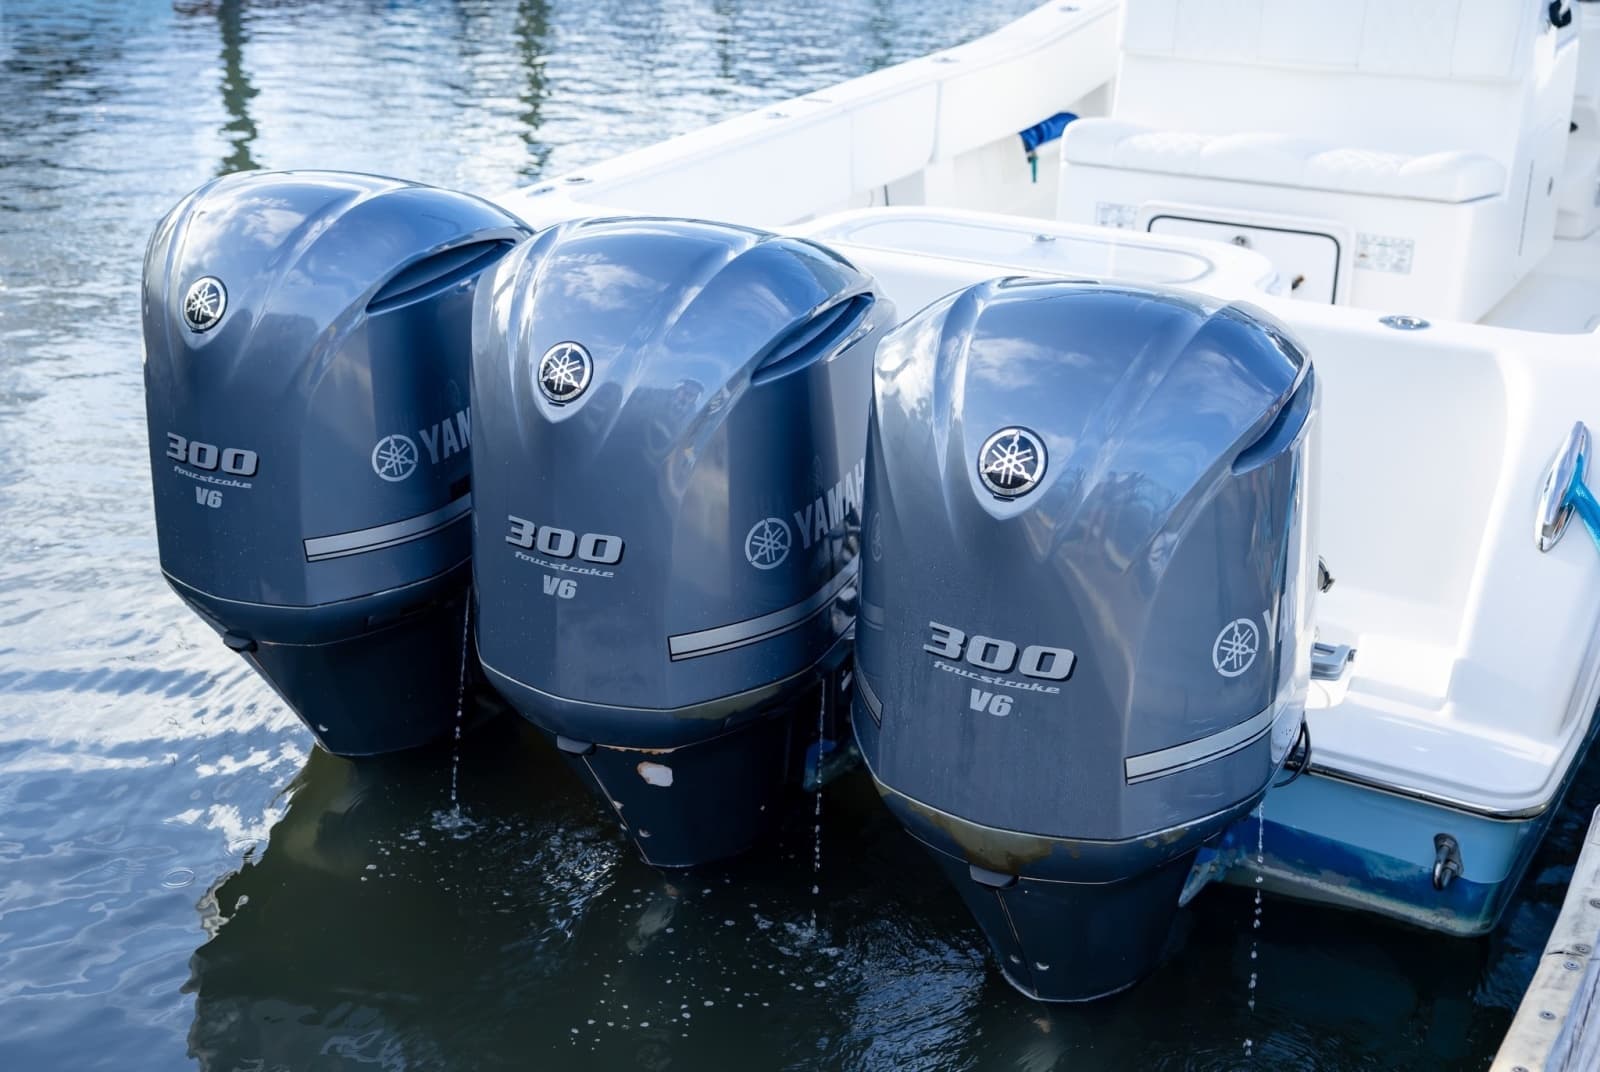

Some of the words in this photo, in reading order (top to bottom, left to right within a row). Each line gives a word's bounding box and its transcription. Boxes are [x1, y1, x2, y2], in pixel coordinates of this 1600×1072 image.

[166, 431, 259, 477] 300
[195, 486, 223, 509] V6
[505, 514, 625, 566] 300
[543, 574, 577, 600] V6
[923, 620, 1077, 682] 300
[969, 687, 1014, 717] V6
